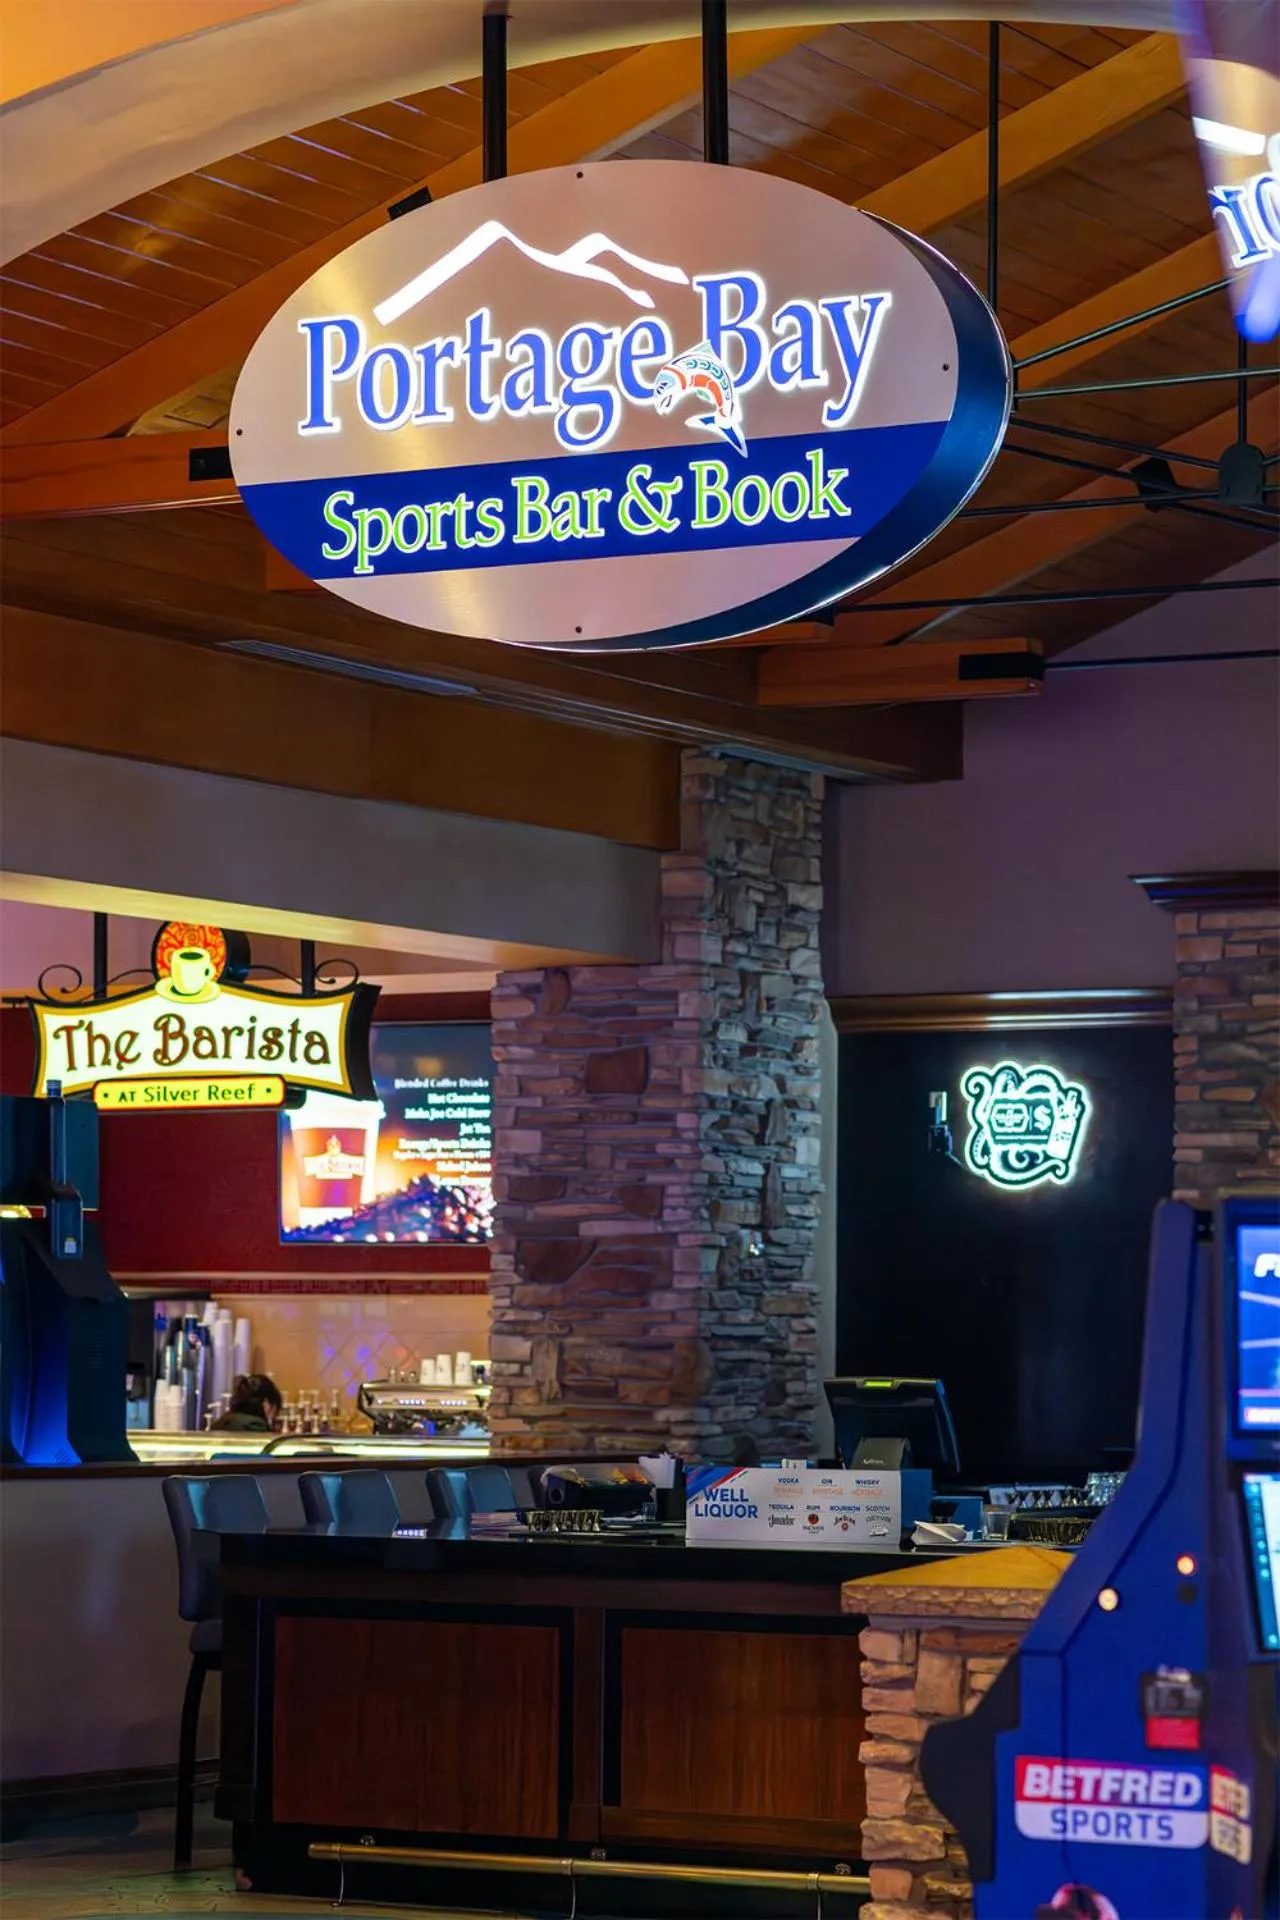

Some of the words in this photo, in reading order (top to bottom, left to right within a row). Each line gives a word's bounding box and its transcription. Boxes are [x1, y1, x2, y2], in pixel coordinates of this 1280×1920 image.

[298, 305, 671, 452] Portage
[693, 270, 892, 428] Bay
[321, 485, 503, 574] Sports
[513, 475, 609, 543] Bar
[618, 463, 682, 536] &
[691, 449, 851, 525] Book
[53, 1019, 142, 1072] The
[152, 1012, 332, 1067] Barista
[117, 1090, 138, 1102] AT
[143, 1085, 203, 1103] Silver
[207, 1082, 256, 1101] Reef
[694, 1503, 759, 1518] LIQUOR
[703, 1488, 750, 1502] WELL
[1022, 1763, 1203, 1807] BETFRED
[1050, 1808, 1175, 1841] SPORTS
